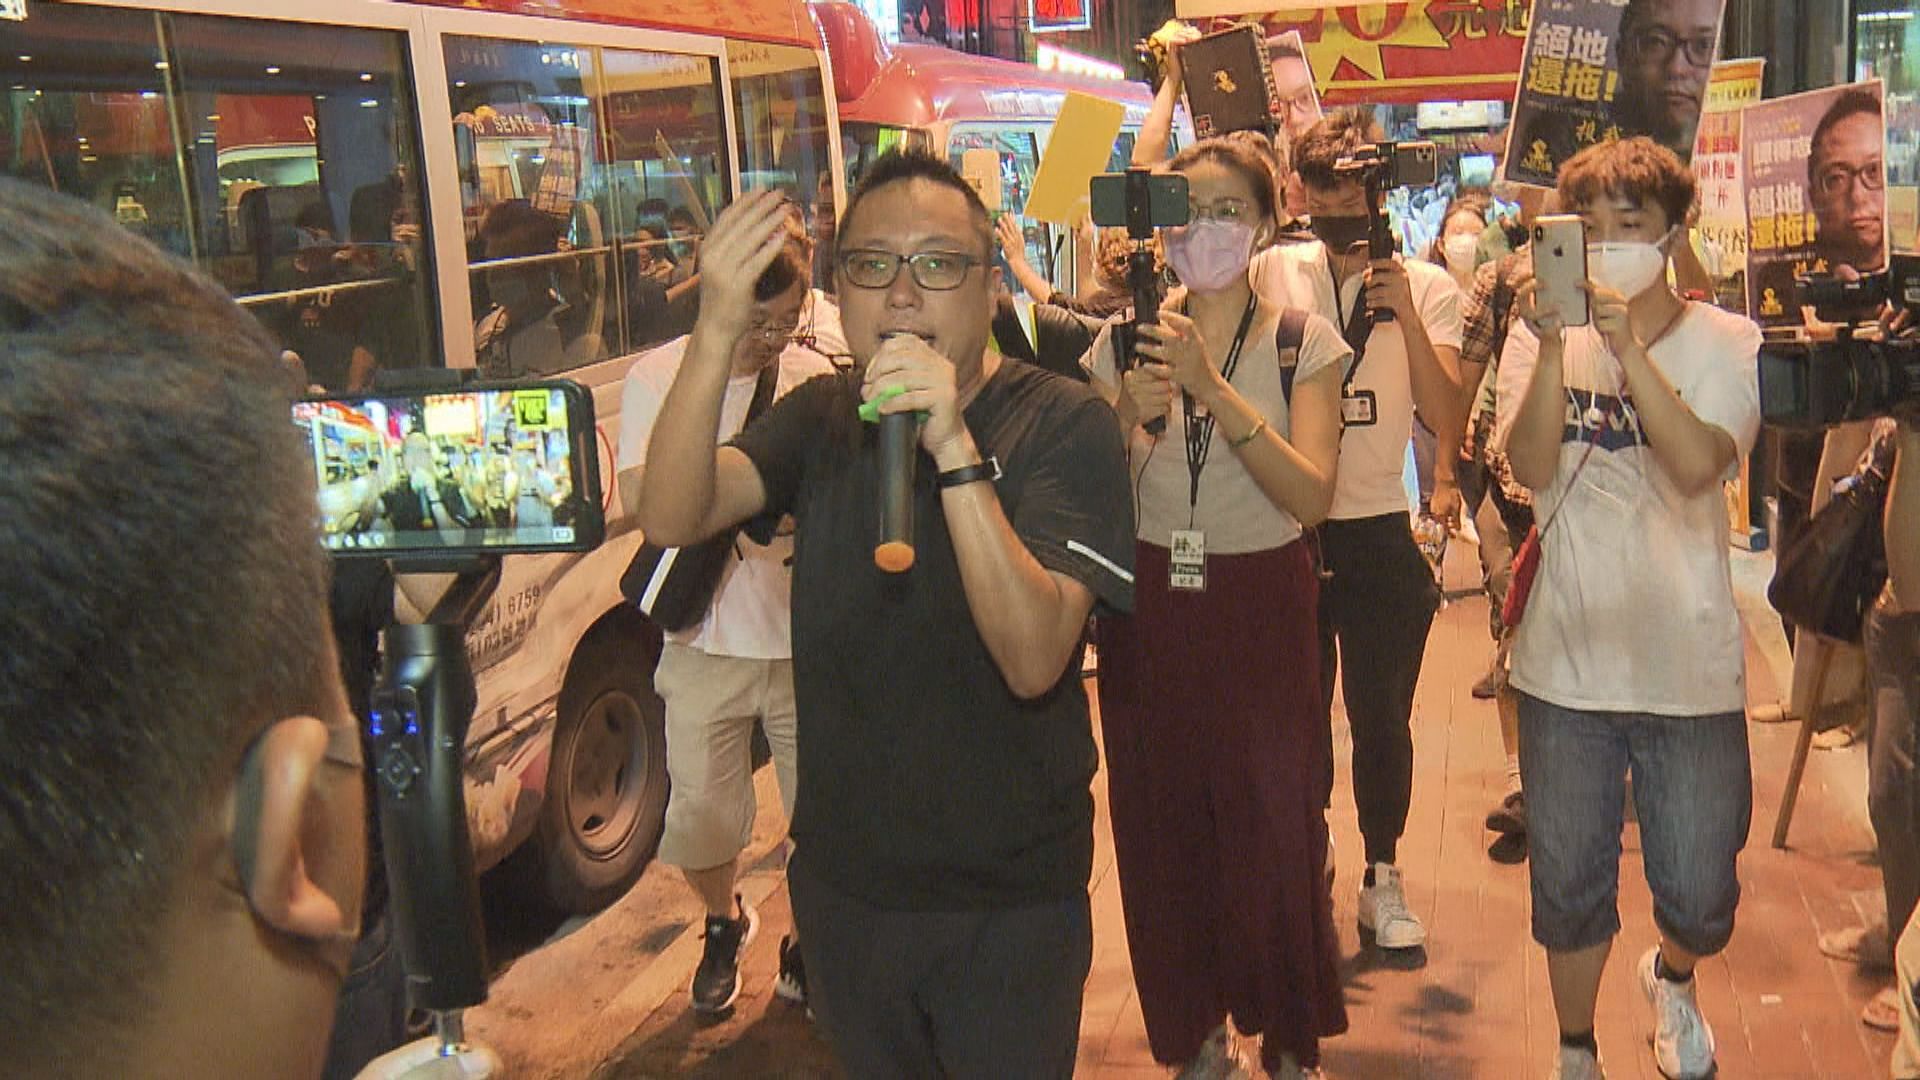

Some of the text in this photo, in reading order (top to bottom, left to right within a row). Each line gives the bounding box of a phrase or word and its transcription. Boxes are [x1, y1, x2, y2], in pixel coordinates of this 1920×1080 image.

[1532, 22, 1609, 66] 絕地
[492, 113, 535, 134] SEATS
[507, 584, 541, 615] 6759
